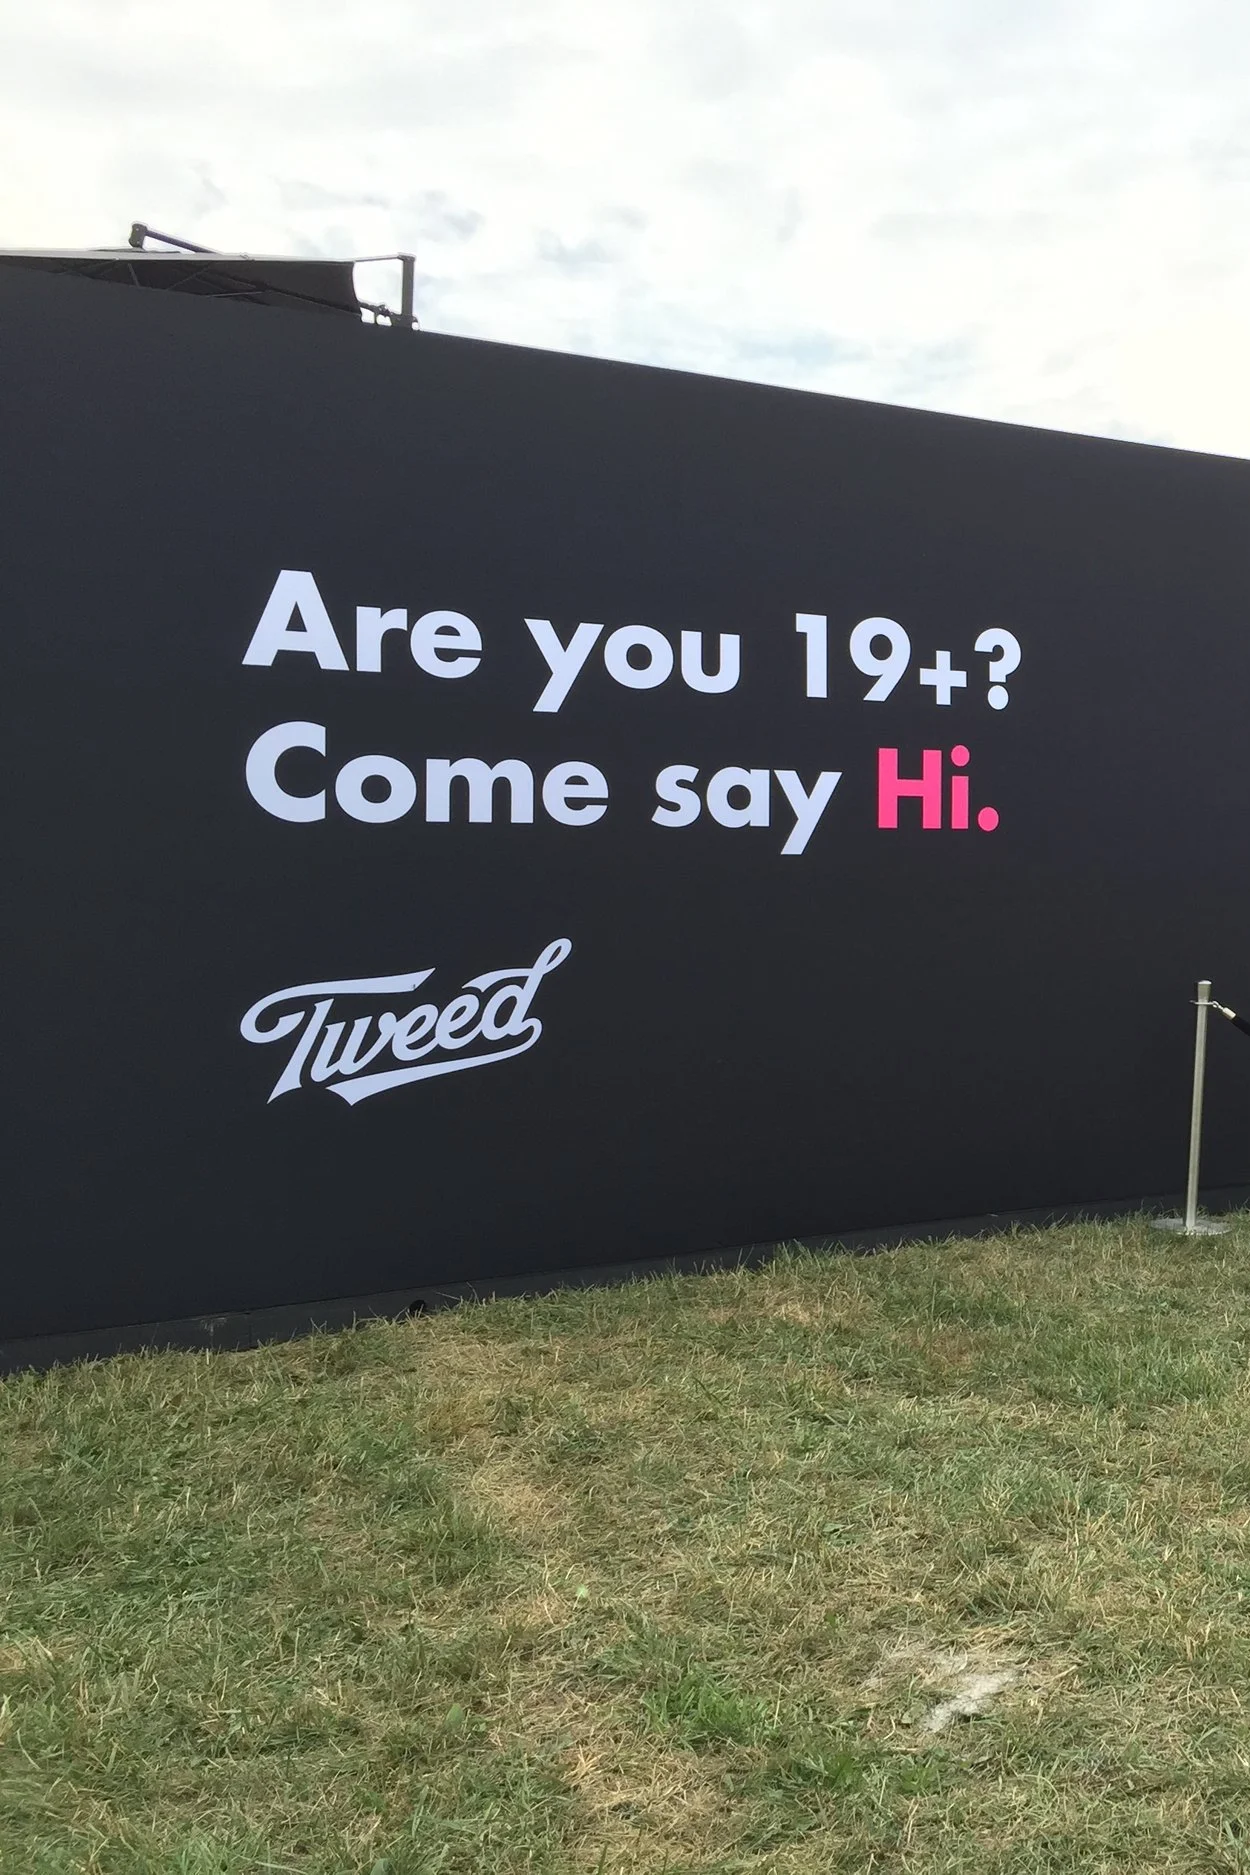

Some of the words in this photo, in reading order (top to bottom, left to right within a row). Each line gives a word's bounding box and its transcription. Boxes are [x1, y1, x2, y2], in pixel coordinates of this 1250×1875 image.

[241, 569, 483, 679] Are
[523, 617, 741, 713] you
[795, 612, 1022, 711] 19+?
[245, 720, 609, 827] Come
[651, 762, 843, 856] say
[877, 744, 1000, 832] Hi.
[240, 937, 573, 1107] Tweed
